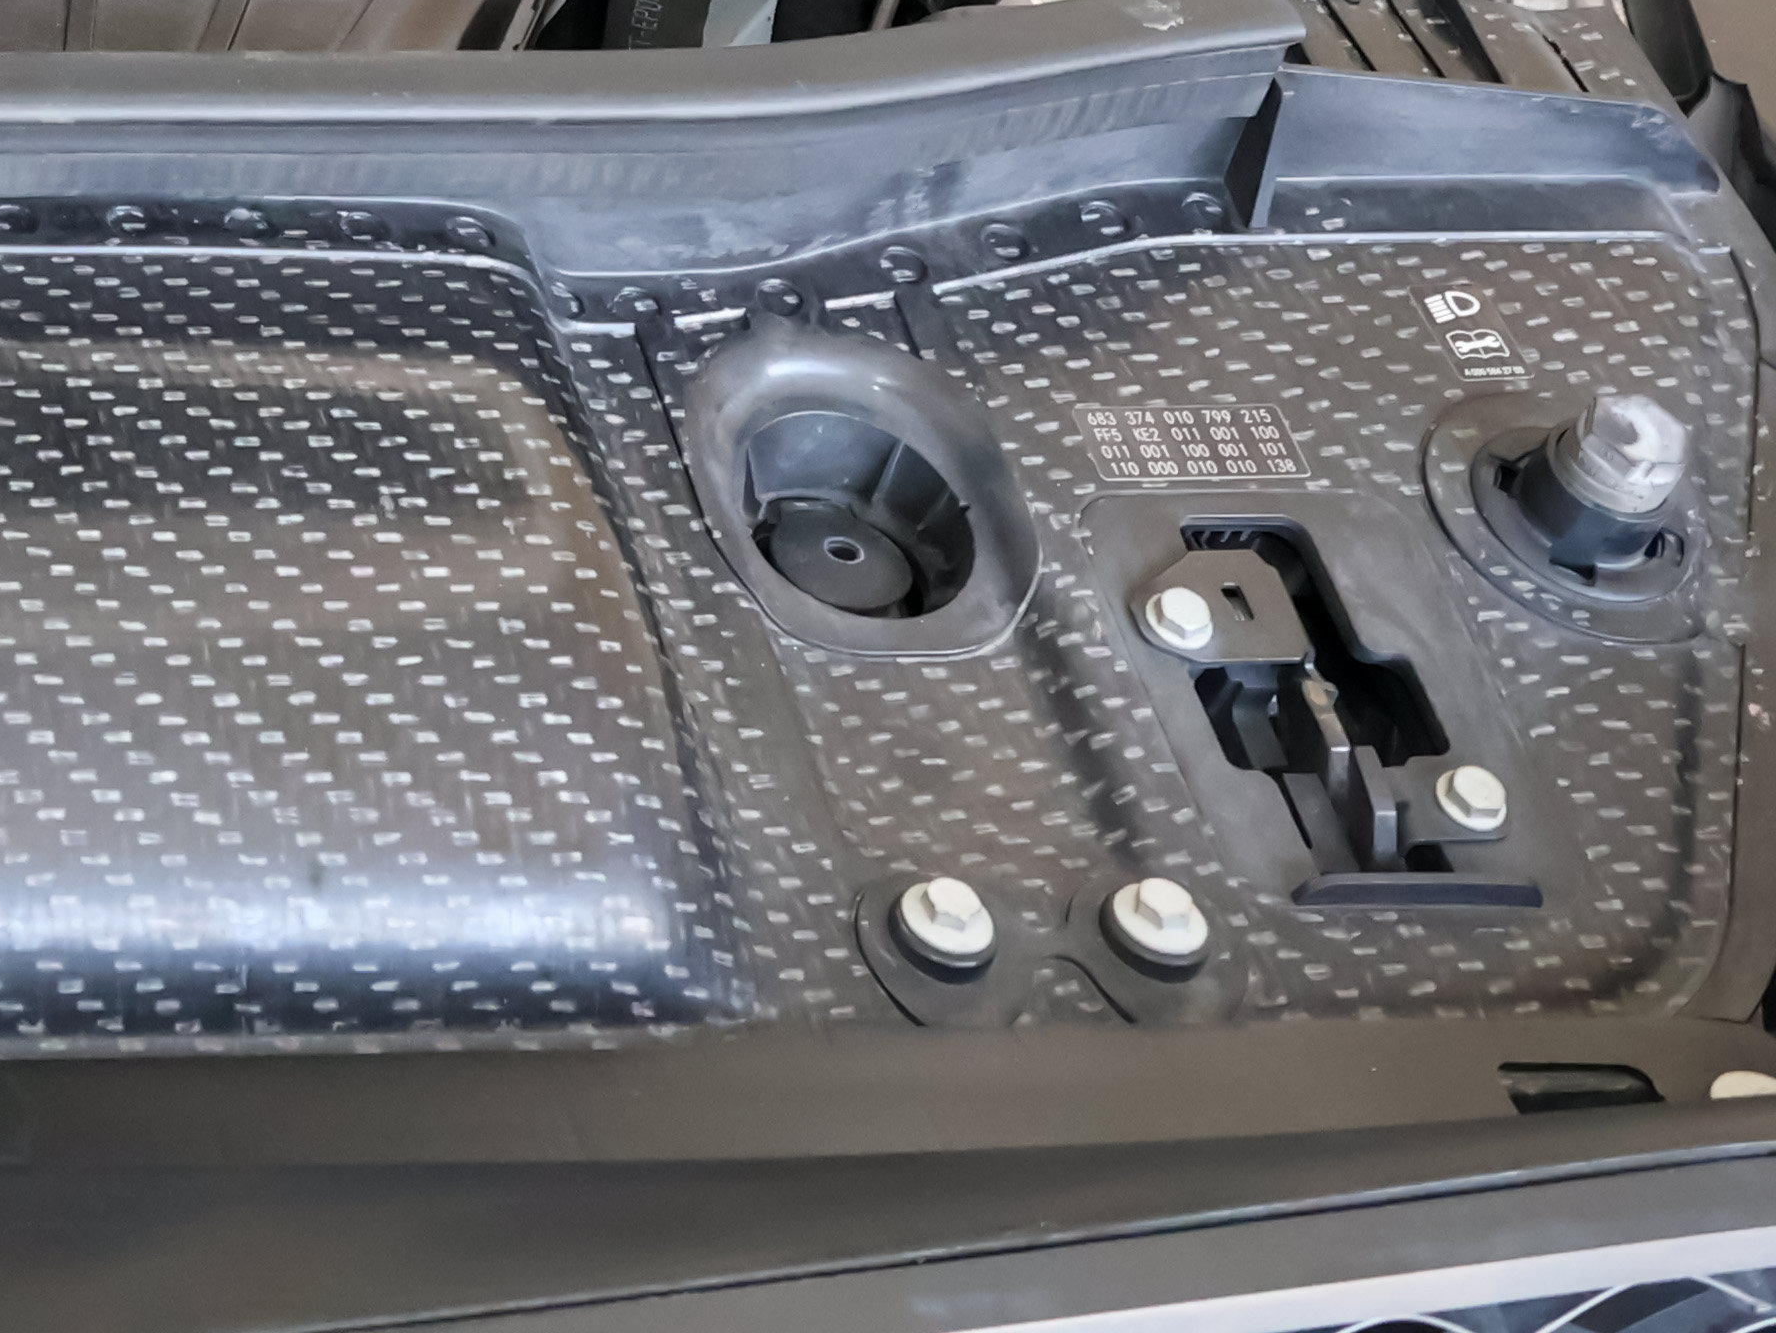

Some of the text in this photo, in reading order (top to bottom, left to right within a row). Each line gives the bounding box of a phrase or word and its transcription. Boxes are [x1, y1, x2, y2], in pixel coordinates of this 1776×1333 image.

[1087, 409, 1271, 426] 683 374 010 799 215
[1093, 425, 1280, 442] FF5 KE2 011 001 100
[1101, 442, 1287, 459] 011 001 100 001 101
[1111, 459, 1297, 476] 110 000 010 010 138
